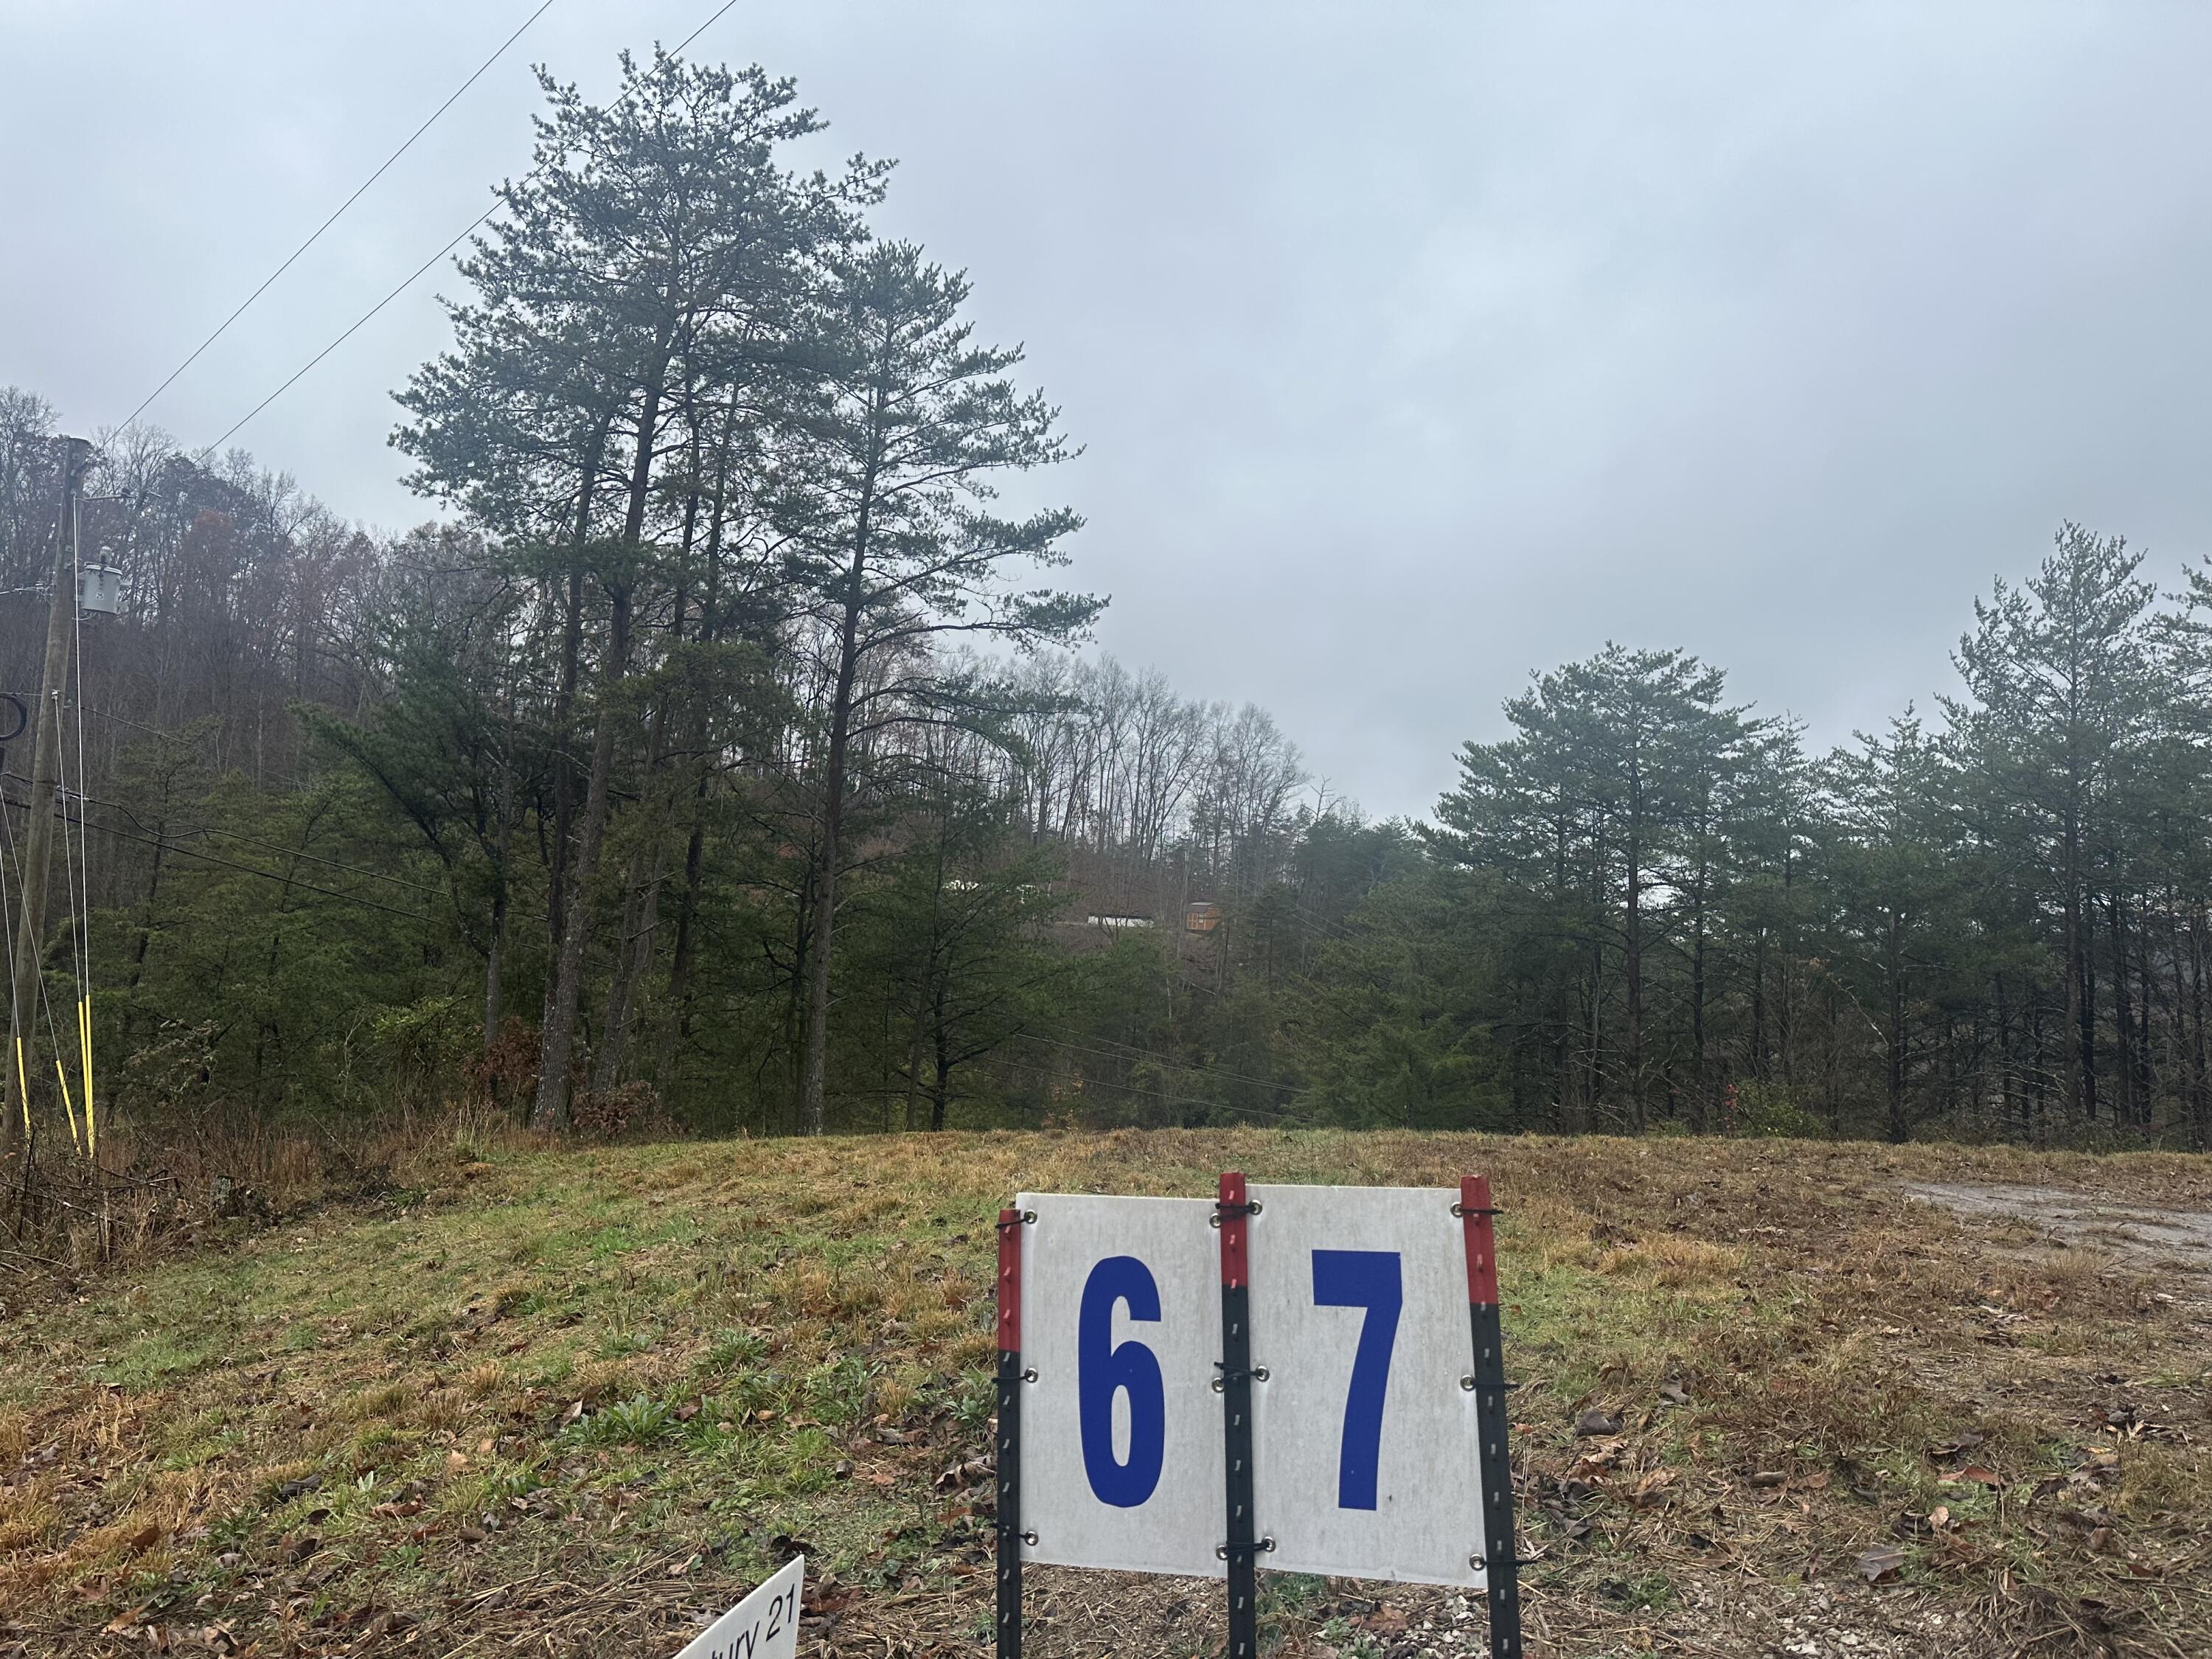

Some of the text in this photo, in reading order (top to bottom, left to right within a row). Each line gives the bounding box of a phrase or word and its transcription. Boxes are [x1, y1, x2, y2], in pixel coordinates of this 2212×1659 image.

[1079, 1256, 1165, 1508] 6
[1312, 1249, 1402, 1511] 7
[712, 1583, 795, 1659] ry 21
